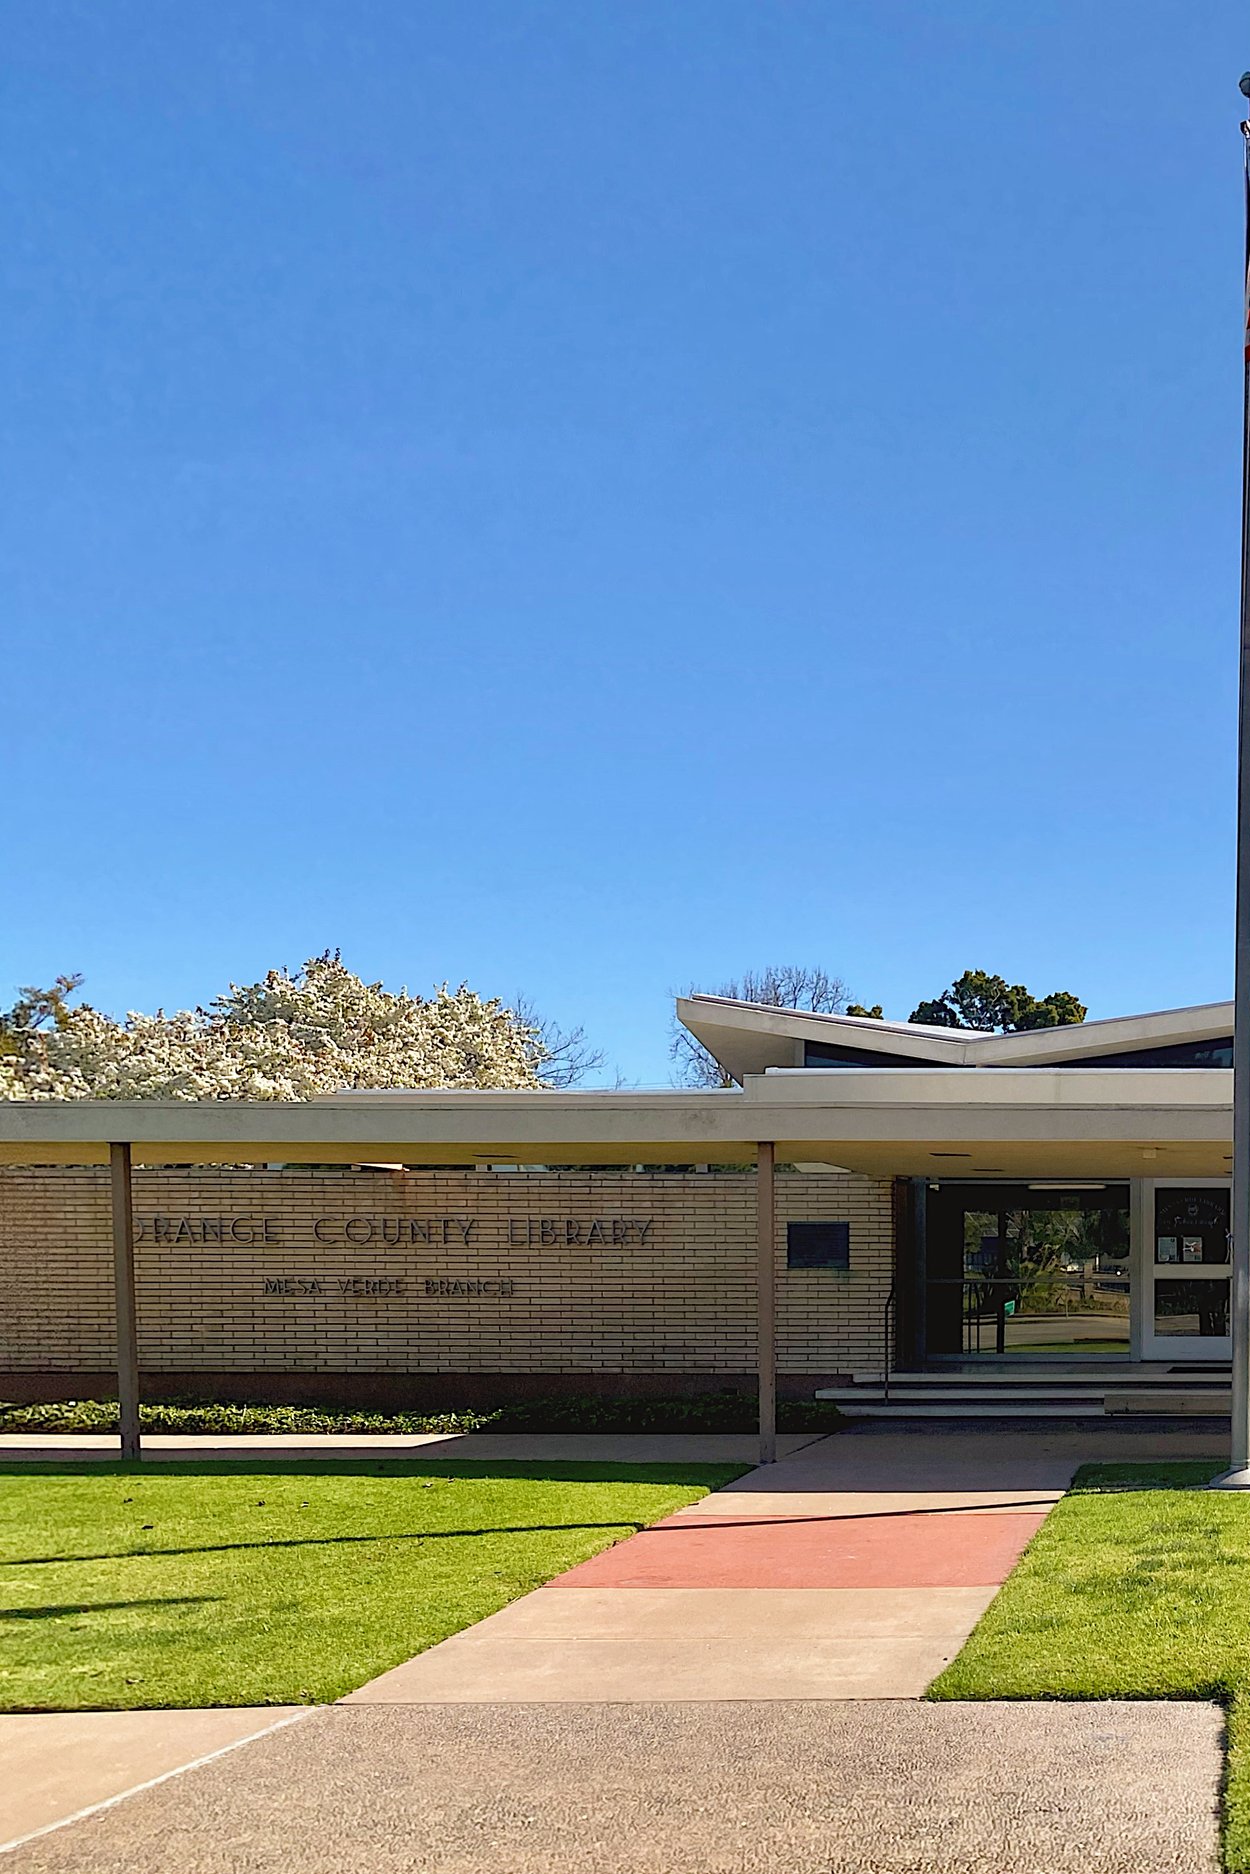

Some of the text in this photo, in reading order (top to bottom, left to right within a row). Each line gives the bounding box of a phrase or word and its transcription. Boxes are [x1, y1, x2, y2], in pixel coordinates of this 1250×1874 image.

[313, 1215, 476, 1246] COUNTY
[508, 1217, 652, 1247] LIBRARY
[264, 1277, 514, 1297] MESA VERDE BRANCH
